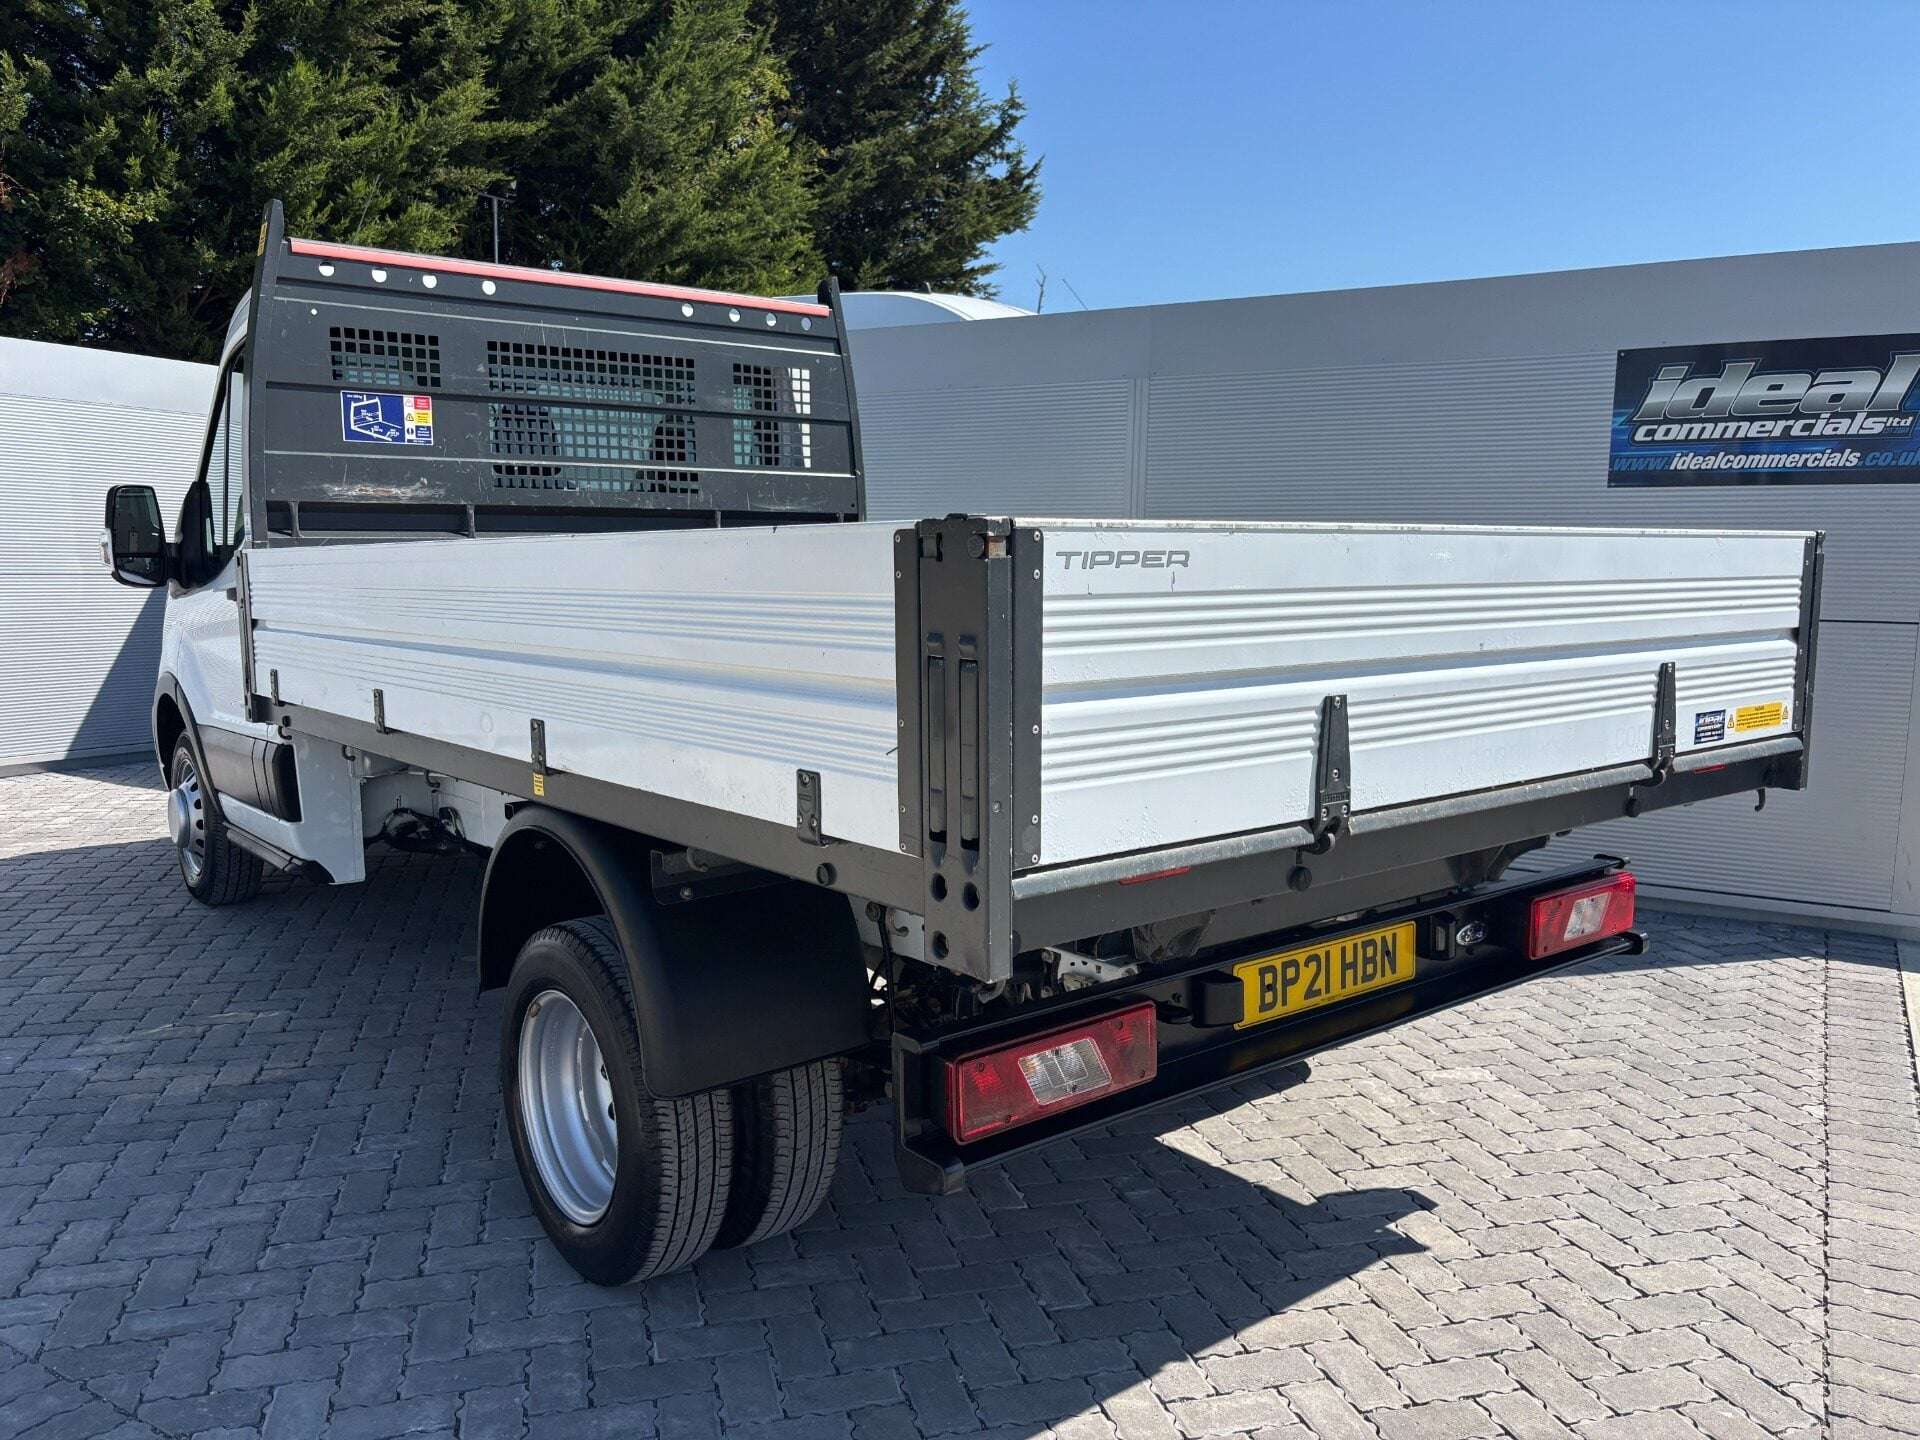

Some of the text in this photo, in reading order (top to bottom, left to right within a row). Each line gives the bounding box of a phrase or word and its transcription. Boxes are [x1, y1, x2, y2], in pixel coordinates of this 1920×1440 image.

[1633, 354, 1920, 421] ideal
[1633, 412, 1914, 442] commercials ltd
[1055, 550, 1191, 570] TIPPER
[1258, 932, 1398, 1013] BP21 HBN
